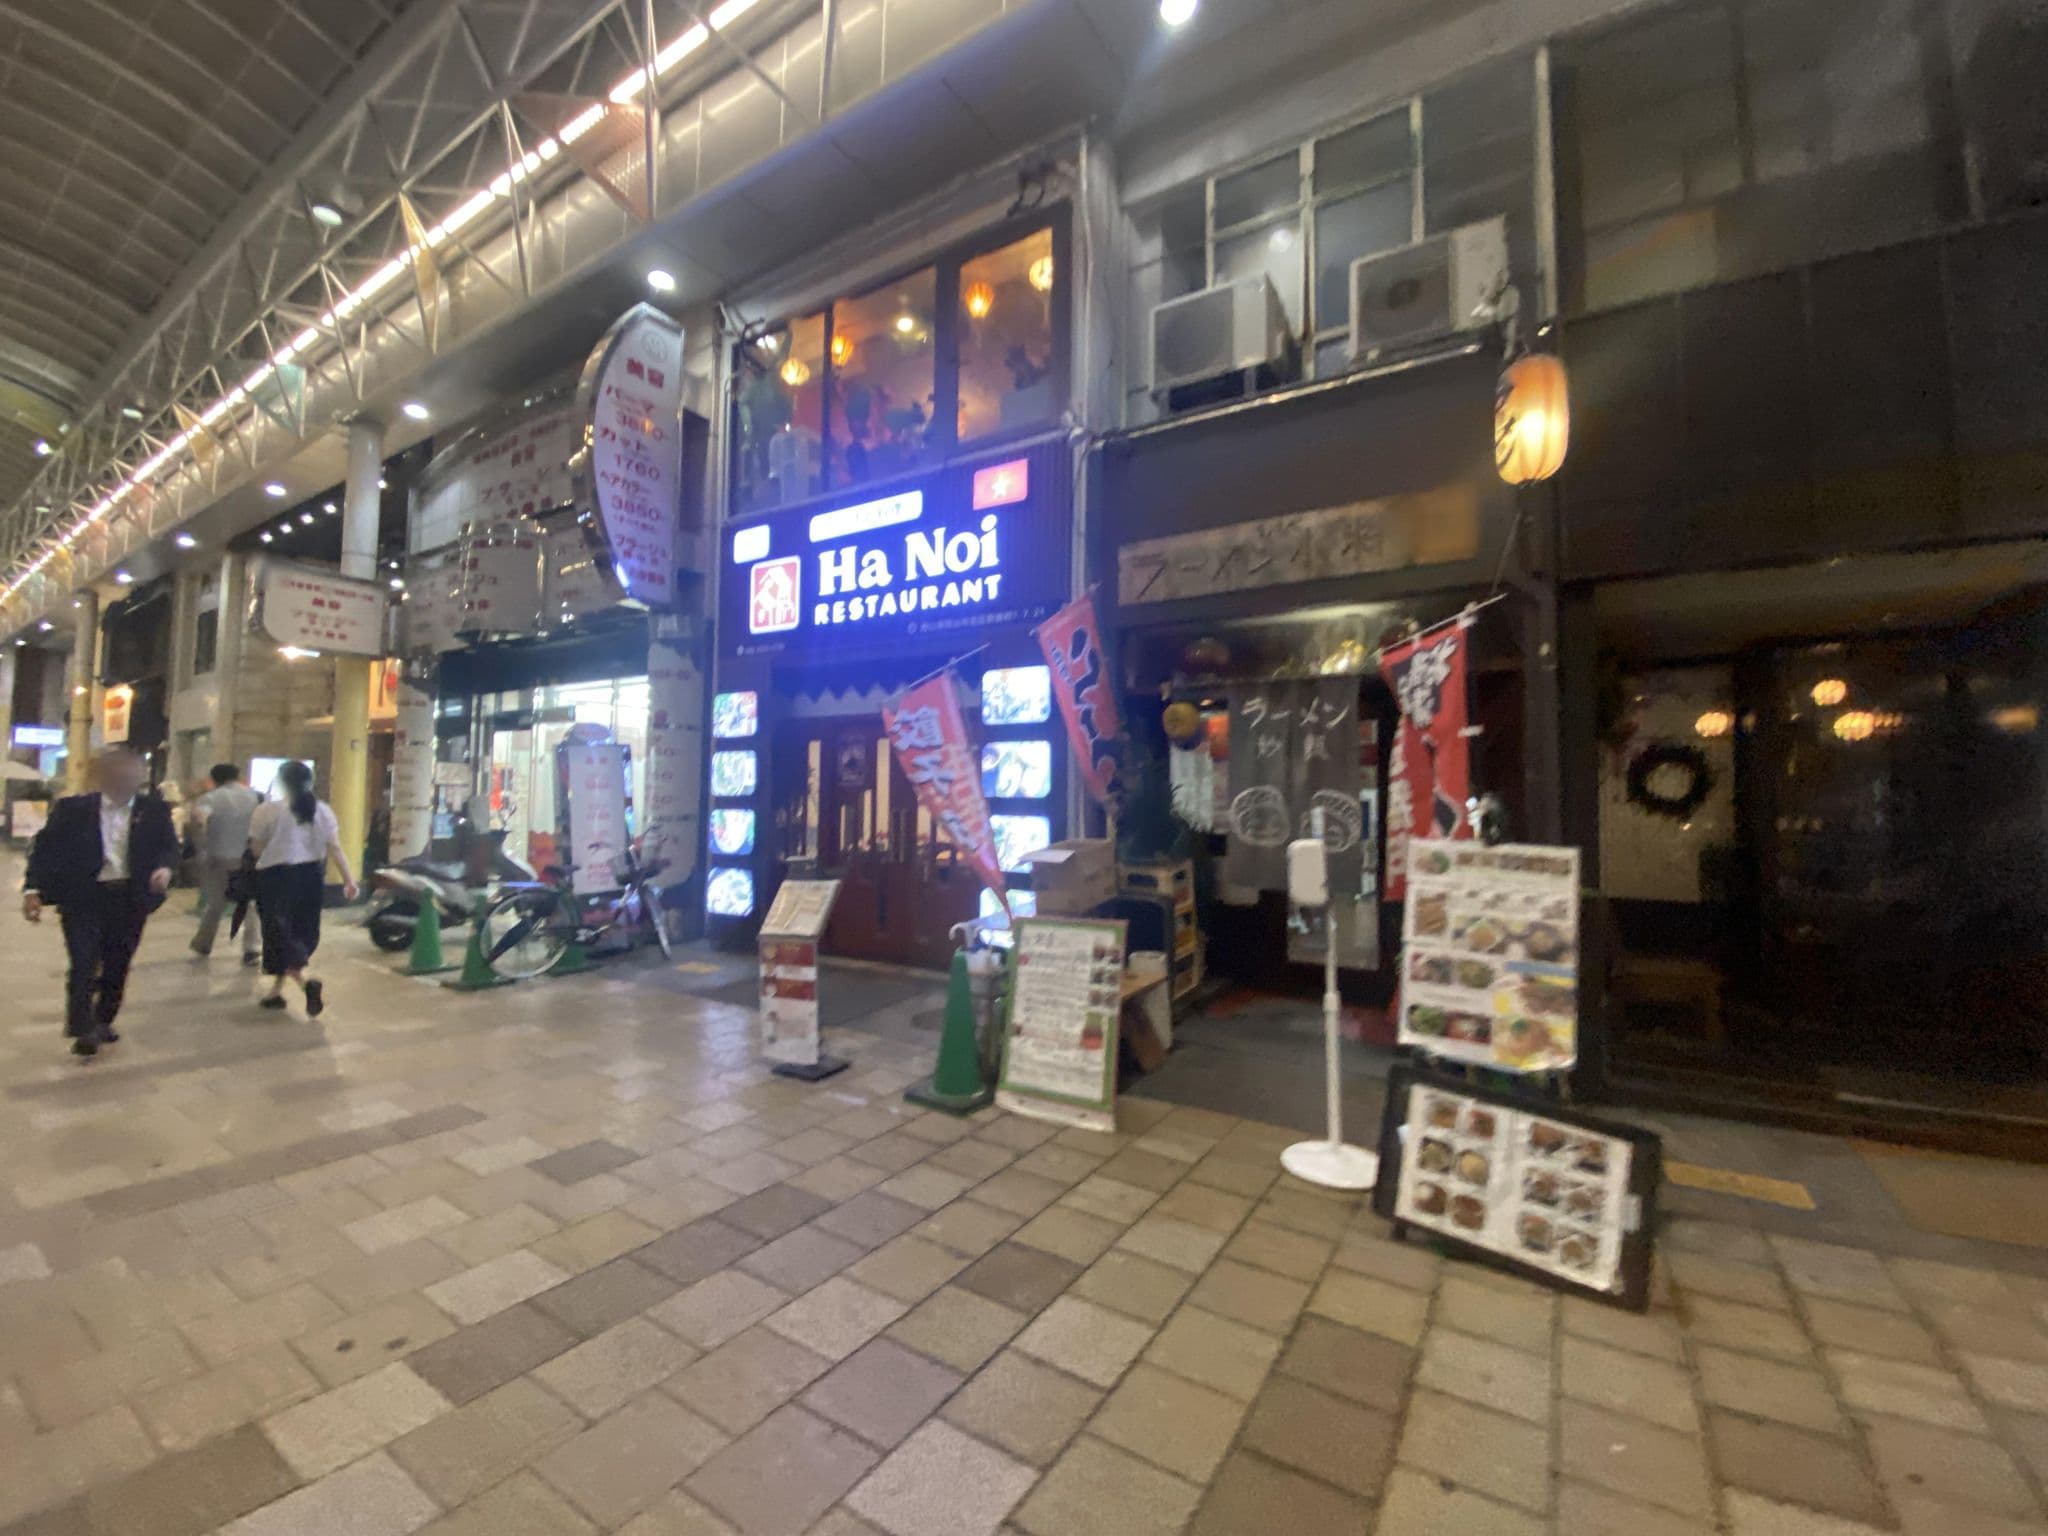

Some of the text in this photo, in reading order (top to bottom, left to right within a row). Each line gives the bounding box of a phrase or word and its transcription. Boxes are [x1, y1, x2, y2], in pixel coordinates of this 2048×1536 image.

[818, 513, 1000, 597] Ha Noi
[814, 574, 1002, 627] RESTAURANT
[1241, 696, 1350, 729] ラーメン
